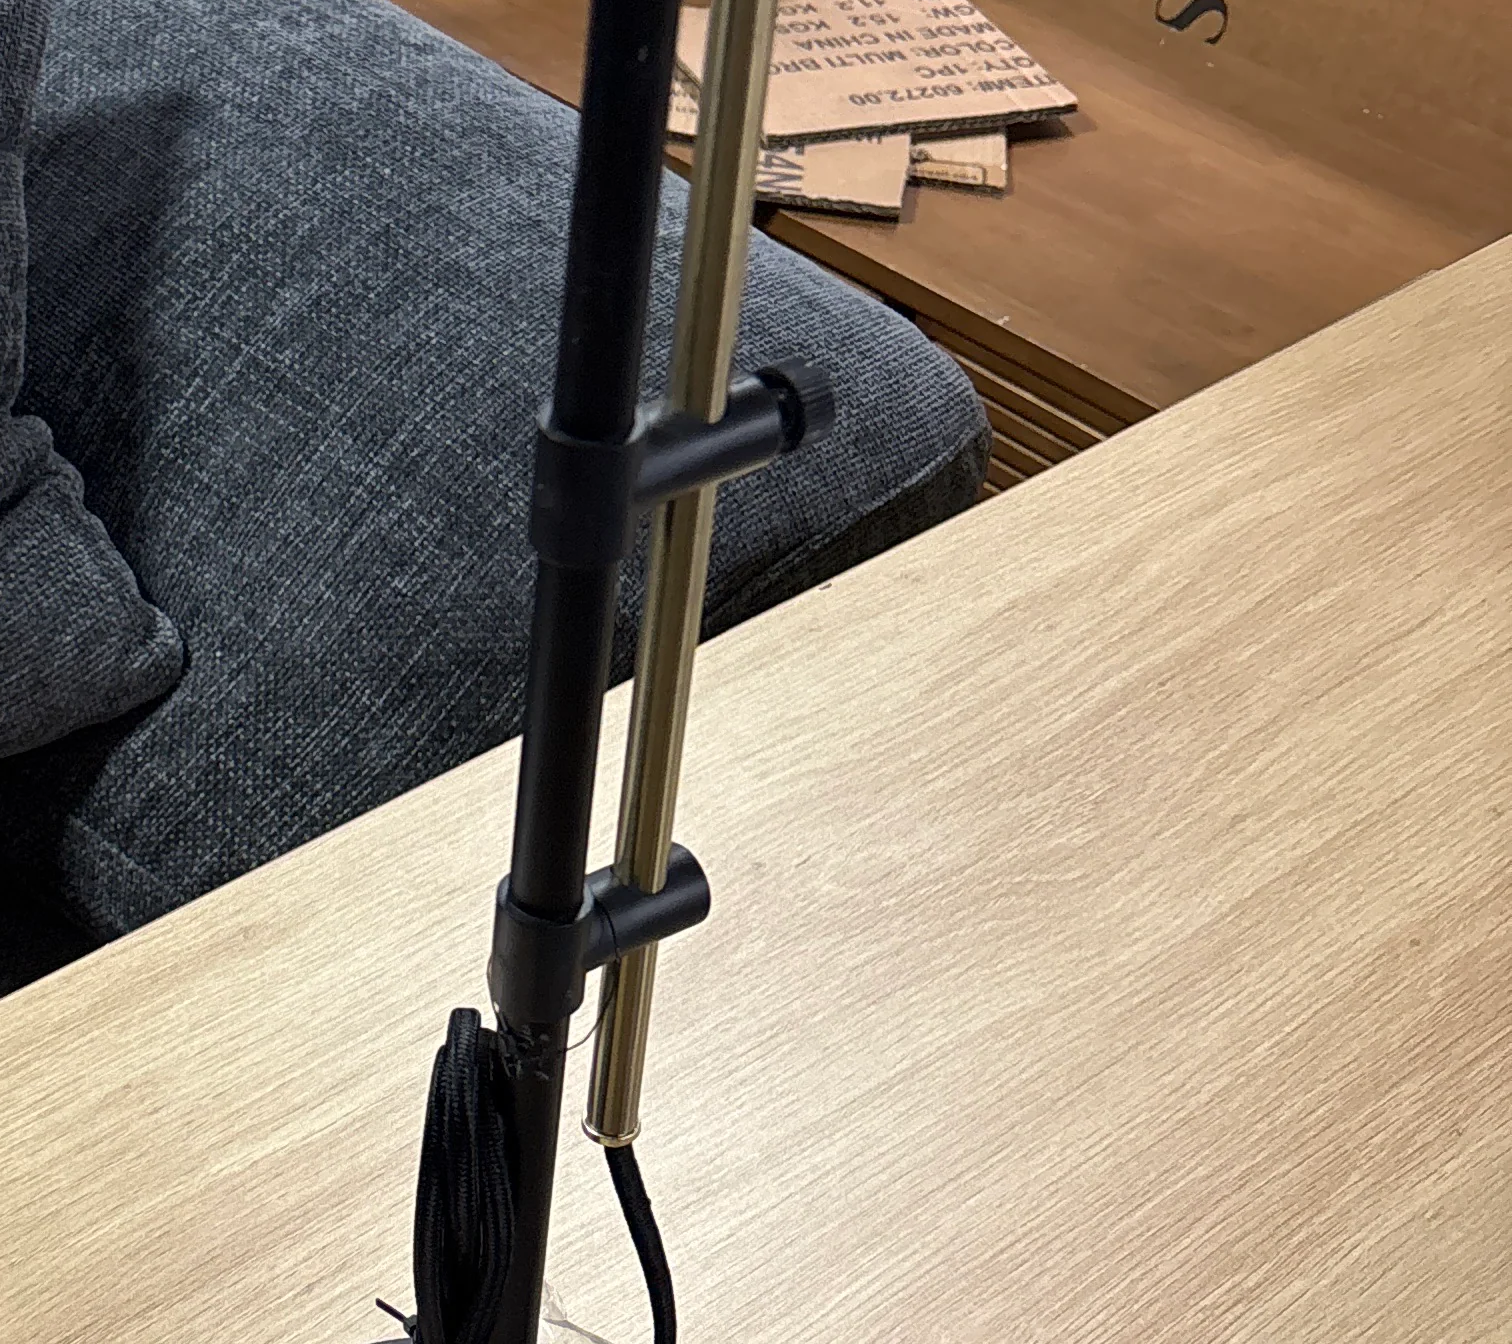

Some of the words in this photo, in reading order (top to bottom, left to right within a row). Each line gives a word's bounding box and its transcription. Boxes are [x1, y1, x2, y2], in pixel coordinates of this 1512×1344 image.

[884, 29, 915, 44] IN
[916, 21, 996, 40] MADE
[792, 32, 880, 52] CHINA
[909, 39, 1014, 58] COLOR:
[824, 50, 908, 69] MULTI
[913, 62, 969, 79] 1PC
